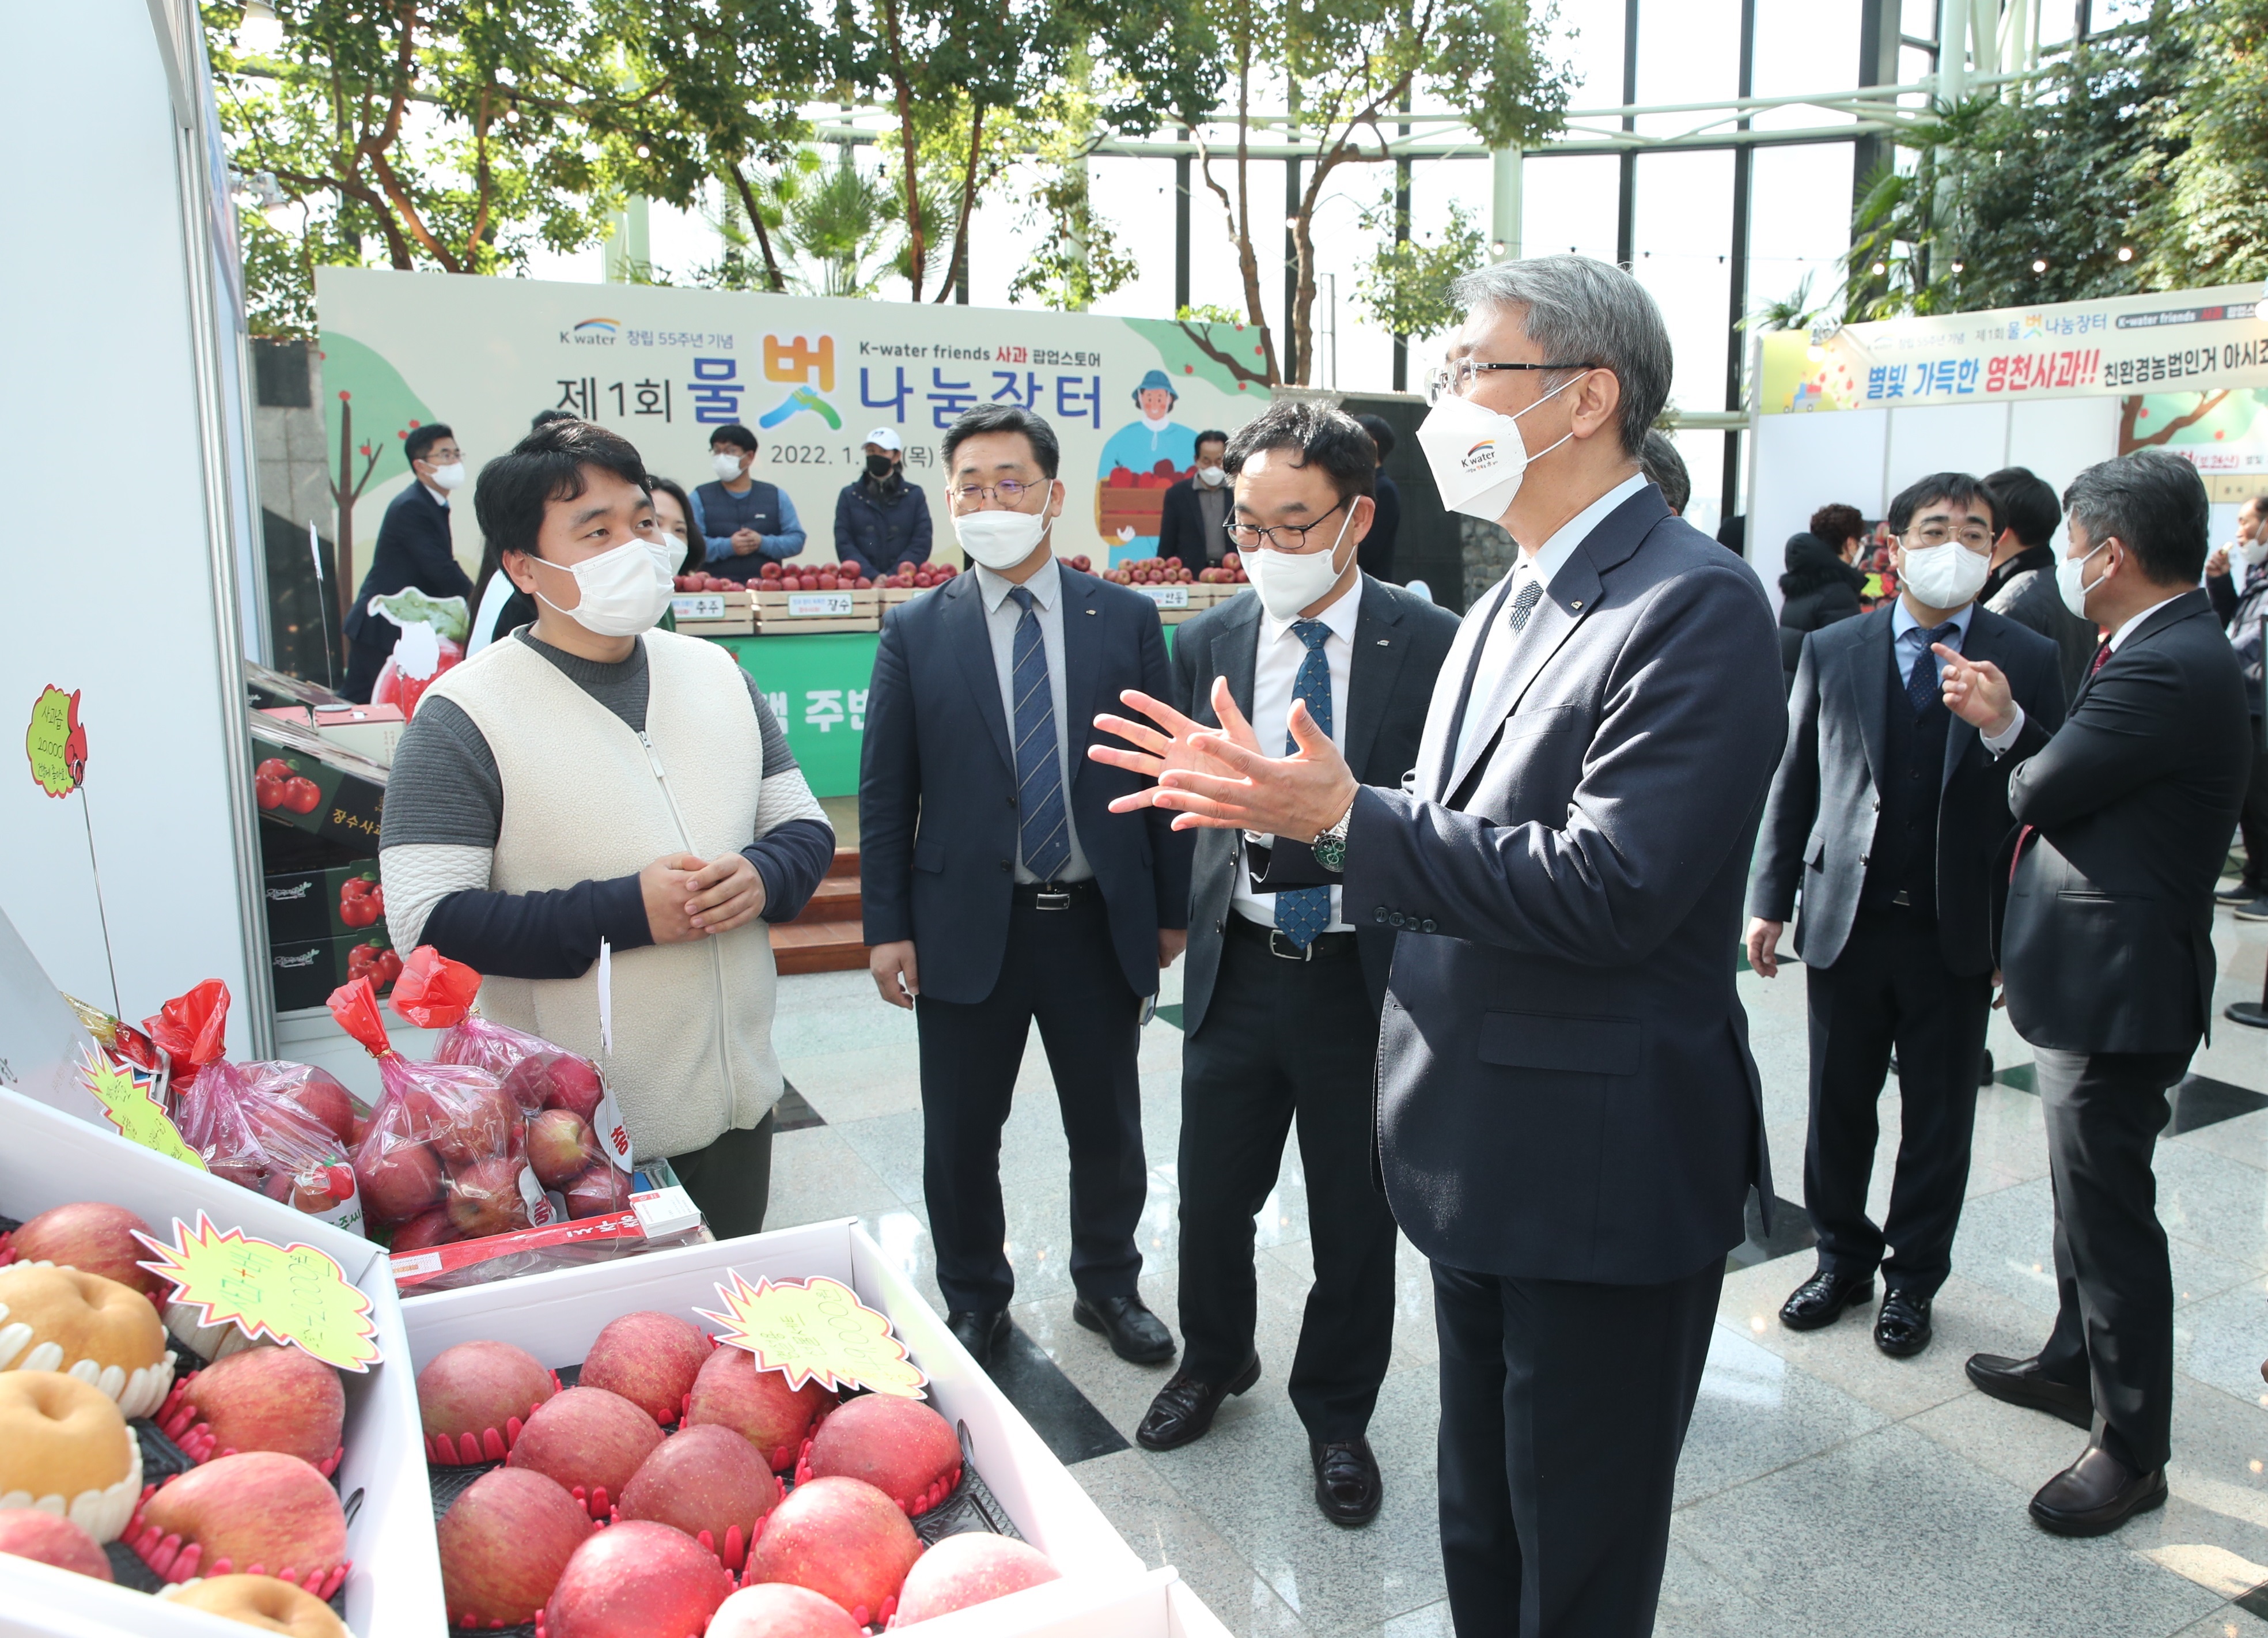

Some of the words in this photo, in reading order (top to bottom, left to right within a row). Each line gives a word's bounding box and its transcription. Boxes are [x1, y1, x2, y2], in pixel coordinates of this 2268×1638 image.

[2118, 315, 2158, 328] K-water
[2160, 311, 2196, 325] friends
[560, 332, 570, 344] K
[575, 332, 616, 346] water
[627, 330, 653, 346] 창립
[659, 332, 703, 349] 55주년
[707, 334, 733, 350] 기념
[860, 341, 927, 358] K-water
[933, 345, 990, 361] friends
[996, 346, 1028, 364] 사과
[1033, 349, 1101, 368] 팝업스토어
[1866, 363, 1907, 400] 별빛
[1913, 357, 1980, 396] 가득한
[1986, 349, 2101, 393] 영천사과!!
[2104, 346, 2217, 387] 친환경농법인거
[771, 445, 833, 464] 2022.
[1470, 451, 1495, 466] water
[828, 598, 850, 612] 장수
[41, 706, 63, 730] 사과즙
[37, 737, 63, 759] 20,000
